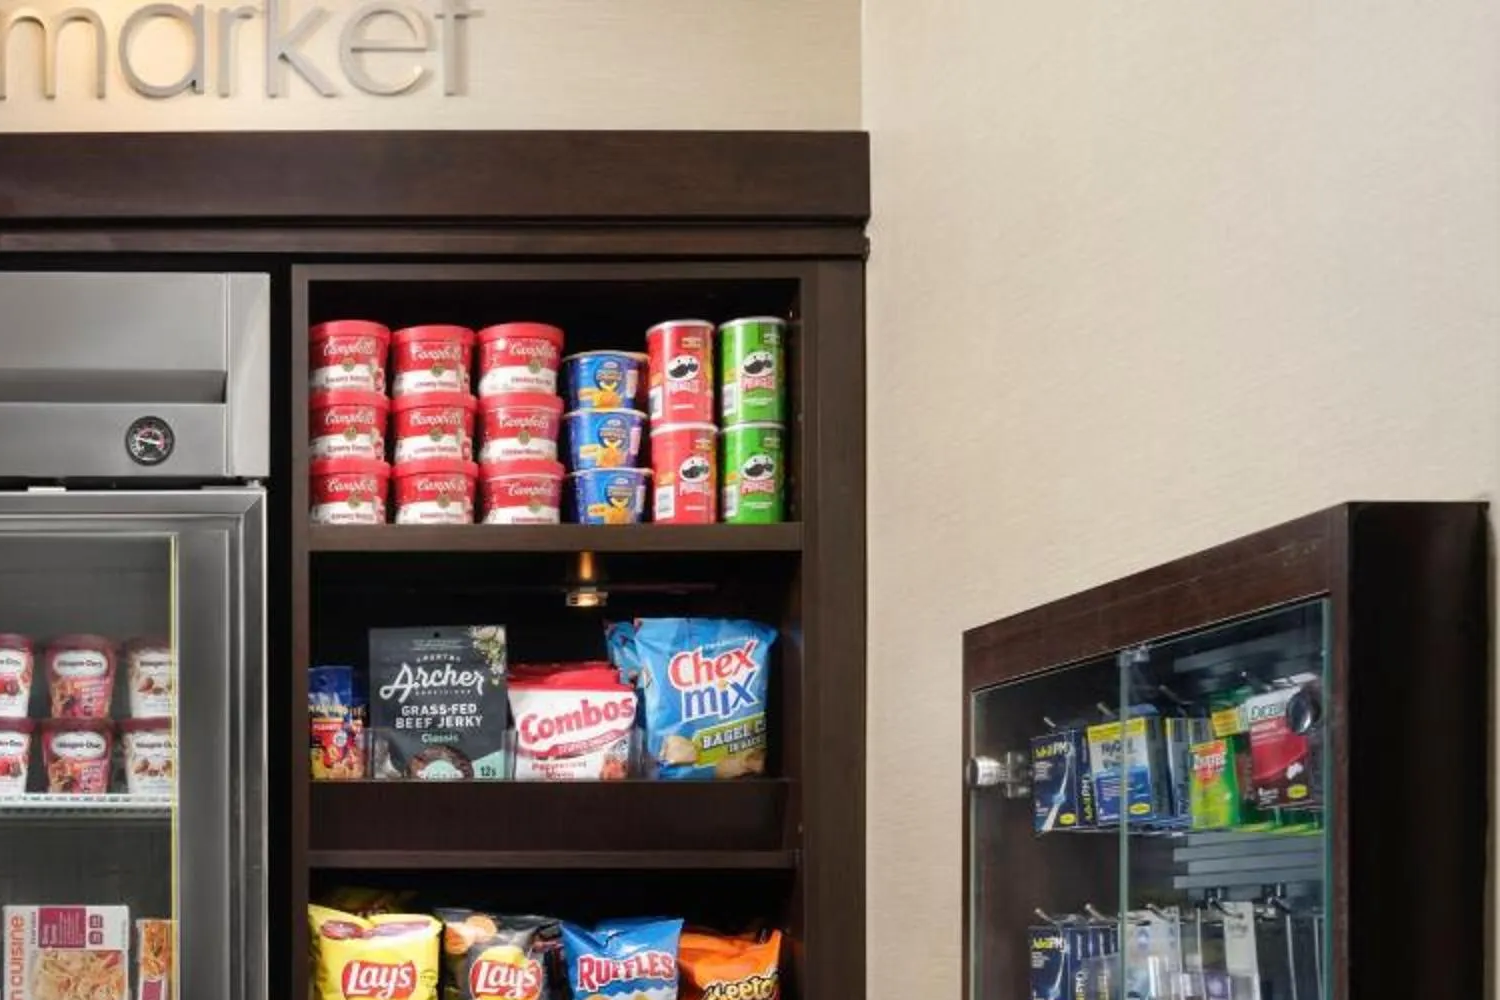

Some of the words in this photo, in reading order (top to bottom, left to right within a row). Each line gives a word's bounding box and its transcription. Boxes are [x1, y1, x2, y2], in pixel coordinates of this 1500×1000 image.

[379, 662, 485, 703] Archer
[669, 640, 758, 689] Chex
[401, 703, 477, 716] GRASS-FED
[683, 672, 756, 719] mix
[395, 717, 432, 729] BEEF
[437, 715, 484, 728] JERKY
[520, 696, 635, 745] Combos
[577, 952, 675, 991] RUFFLES
